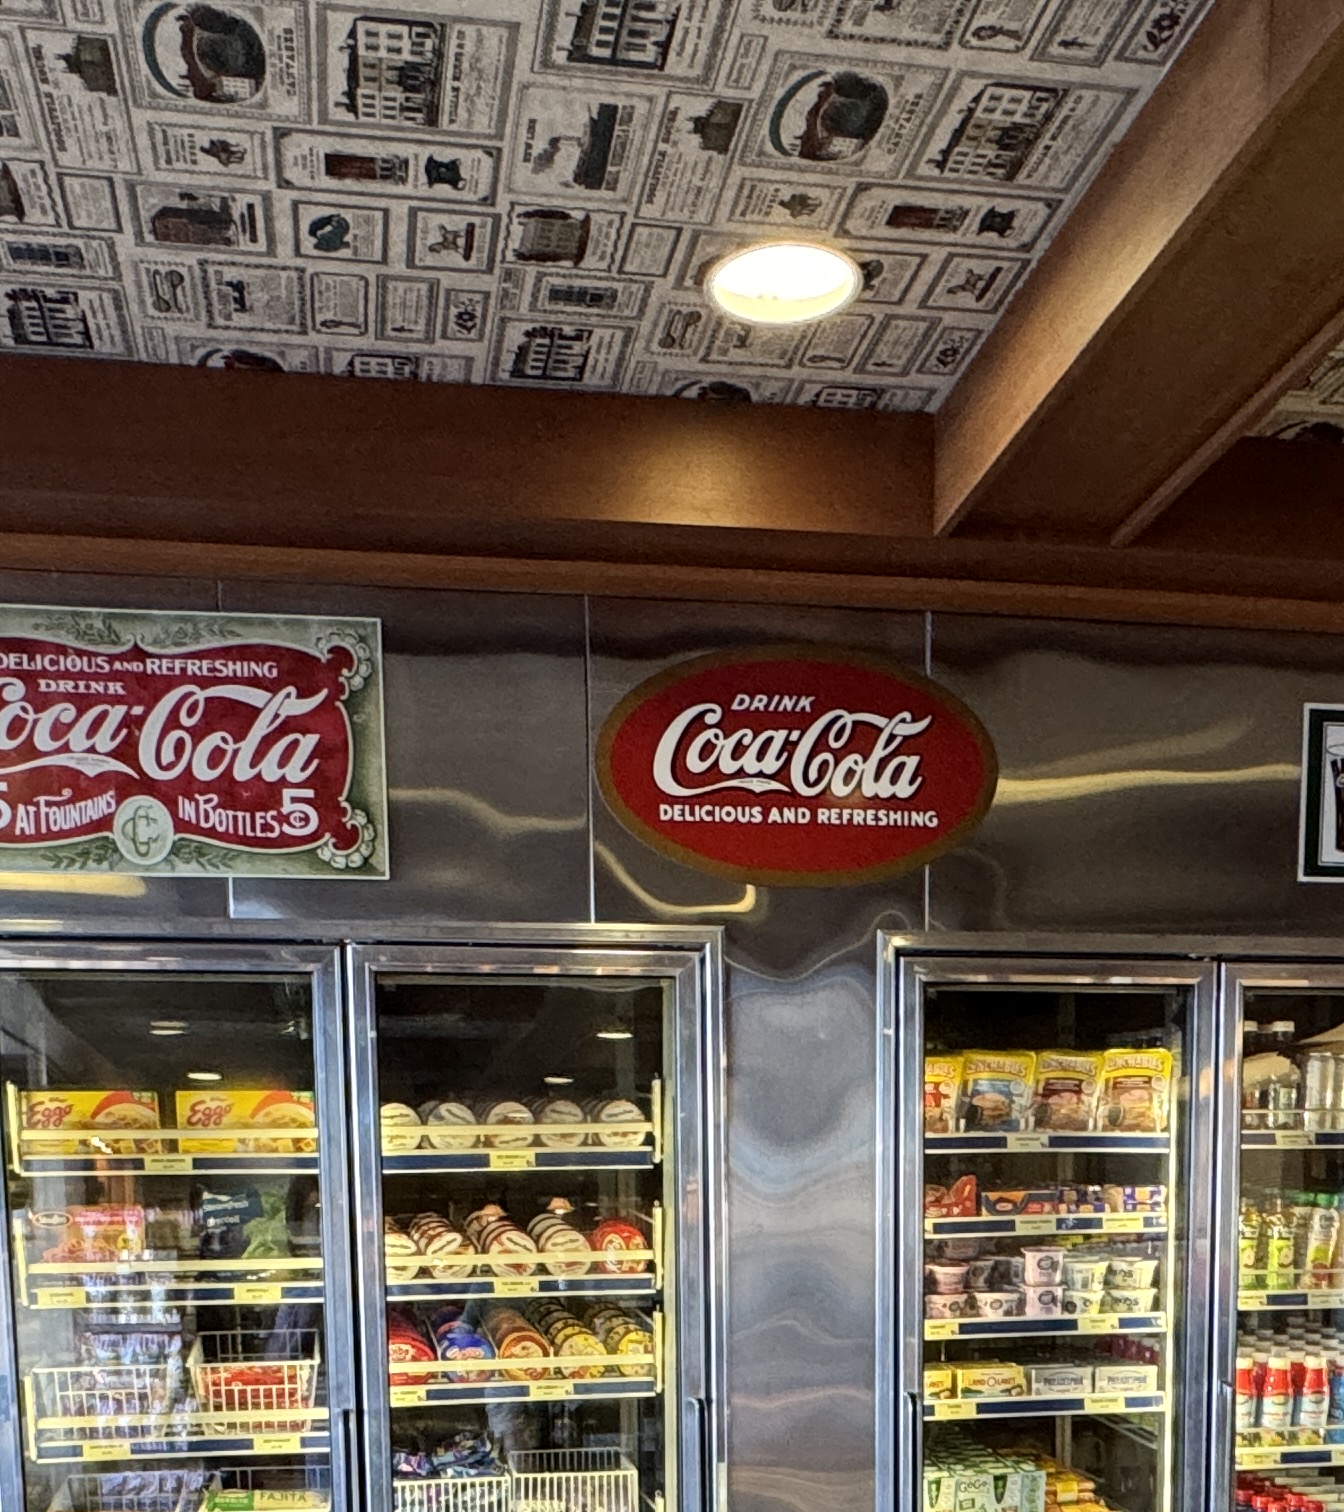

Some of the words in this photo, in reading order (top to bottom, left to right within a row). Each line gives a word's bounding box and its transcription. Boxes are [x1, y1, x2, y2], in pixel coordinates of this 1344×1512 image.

[112, 661, 144, 673] AND
[147, 657, 278, 679] REFRESHING
[37, 679, 126, 695] DRINK
[731, 693, 816, 713] DRINK
[652, 703, 932, 799] Coca-Cola
[14, 803, 37, 835] AT
[178, 795, 196, 825] IN
[196, 796, 280, 838] BOTTLES
[659, 803, 763, 824] DELICIOUS
[767, 804, 811, 824] AND
[817, 806, 939, 828] REFRESHING
[28, 1100, 74, 1128] Eggo
[186, 1100, 235, 1128] Eggo
